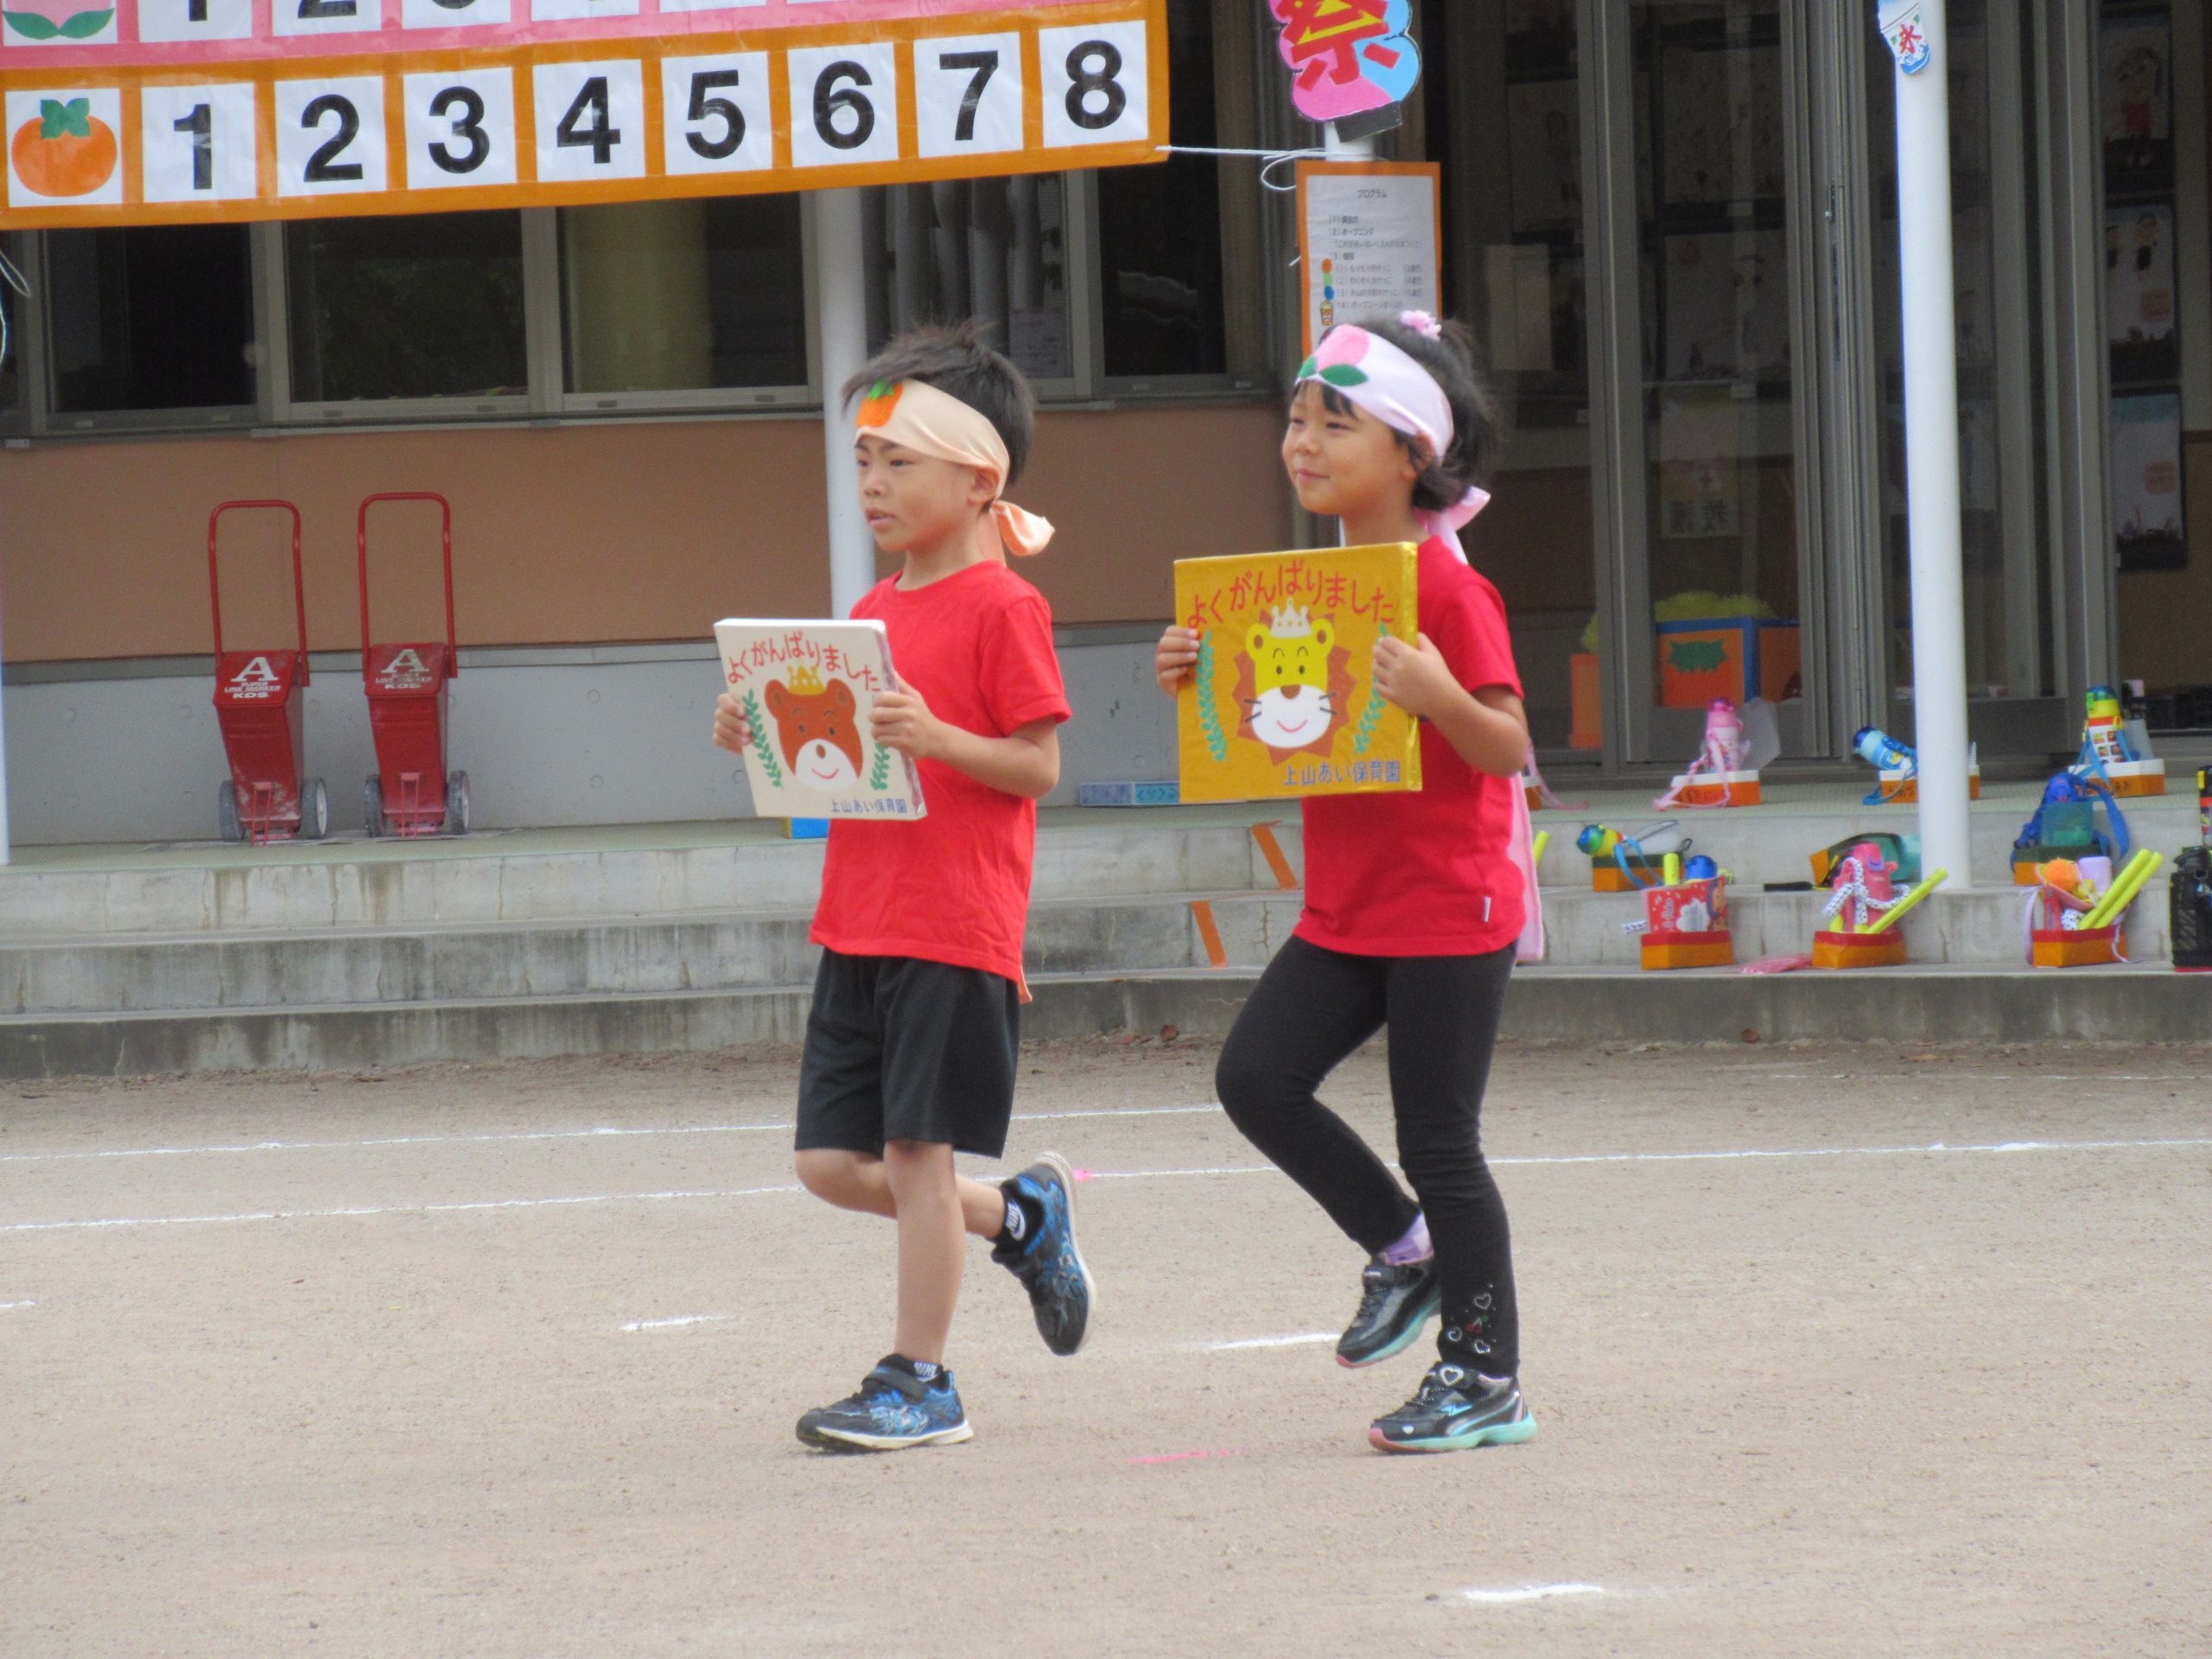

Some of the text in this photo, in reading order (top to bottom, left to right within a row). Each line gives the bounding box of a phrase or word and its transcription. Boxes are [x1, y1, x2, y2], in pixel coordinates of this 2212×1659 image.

[1898, 23, 1923, 54] 氷
[174, 40, 1127, 190] 1 2 3 4 5 6 7 8
[1357, 188, 1388, 199] プログラム
[1187, 559, 1395, 629] よくがんばりました
[231, 657, 279, 682] A
[380, 649, 429, 673] A
[728, 630, 881, 692] よくがんばりました
[1282, 760, 1401, 786] 上山あい保育園
[830, 798, 907, 814] 上山あい保育園
